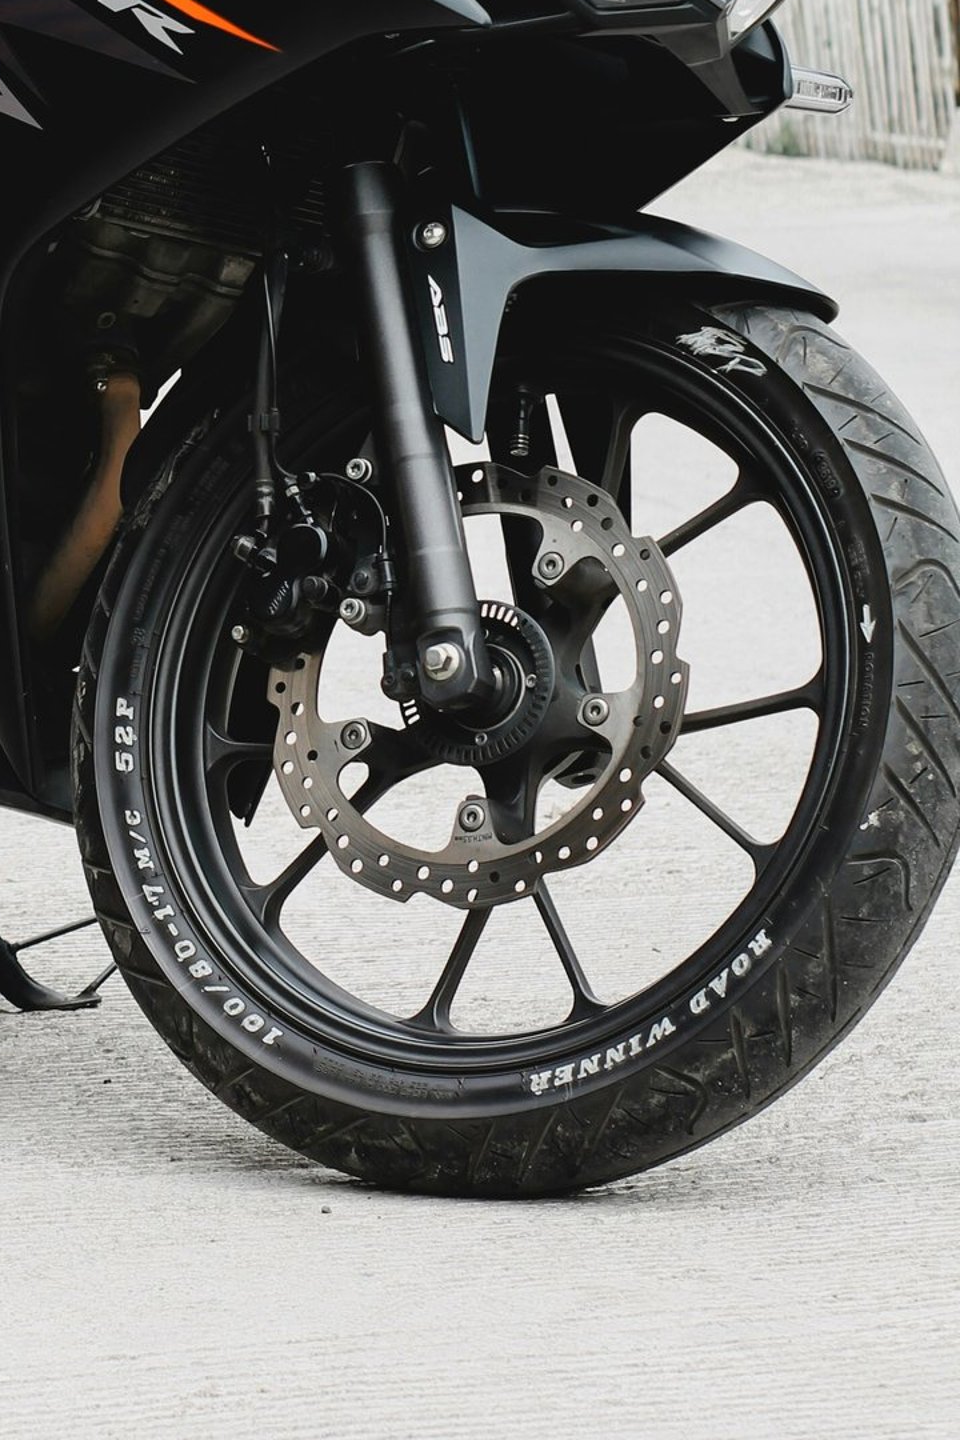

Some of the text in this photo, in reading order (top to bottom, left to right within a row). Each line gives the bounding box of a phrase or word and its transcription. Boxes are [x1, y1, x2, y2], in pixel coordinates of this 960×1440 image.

[427, 274, 454, 363] ABS
[115, 697, 136, 774] 52P
[689, 928, 773, 1015] ROAD
[529, 1016, 677, 1096] WINNER
